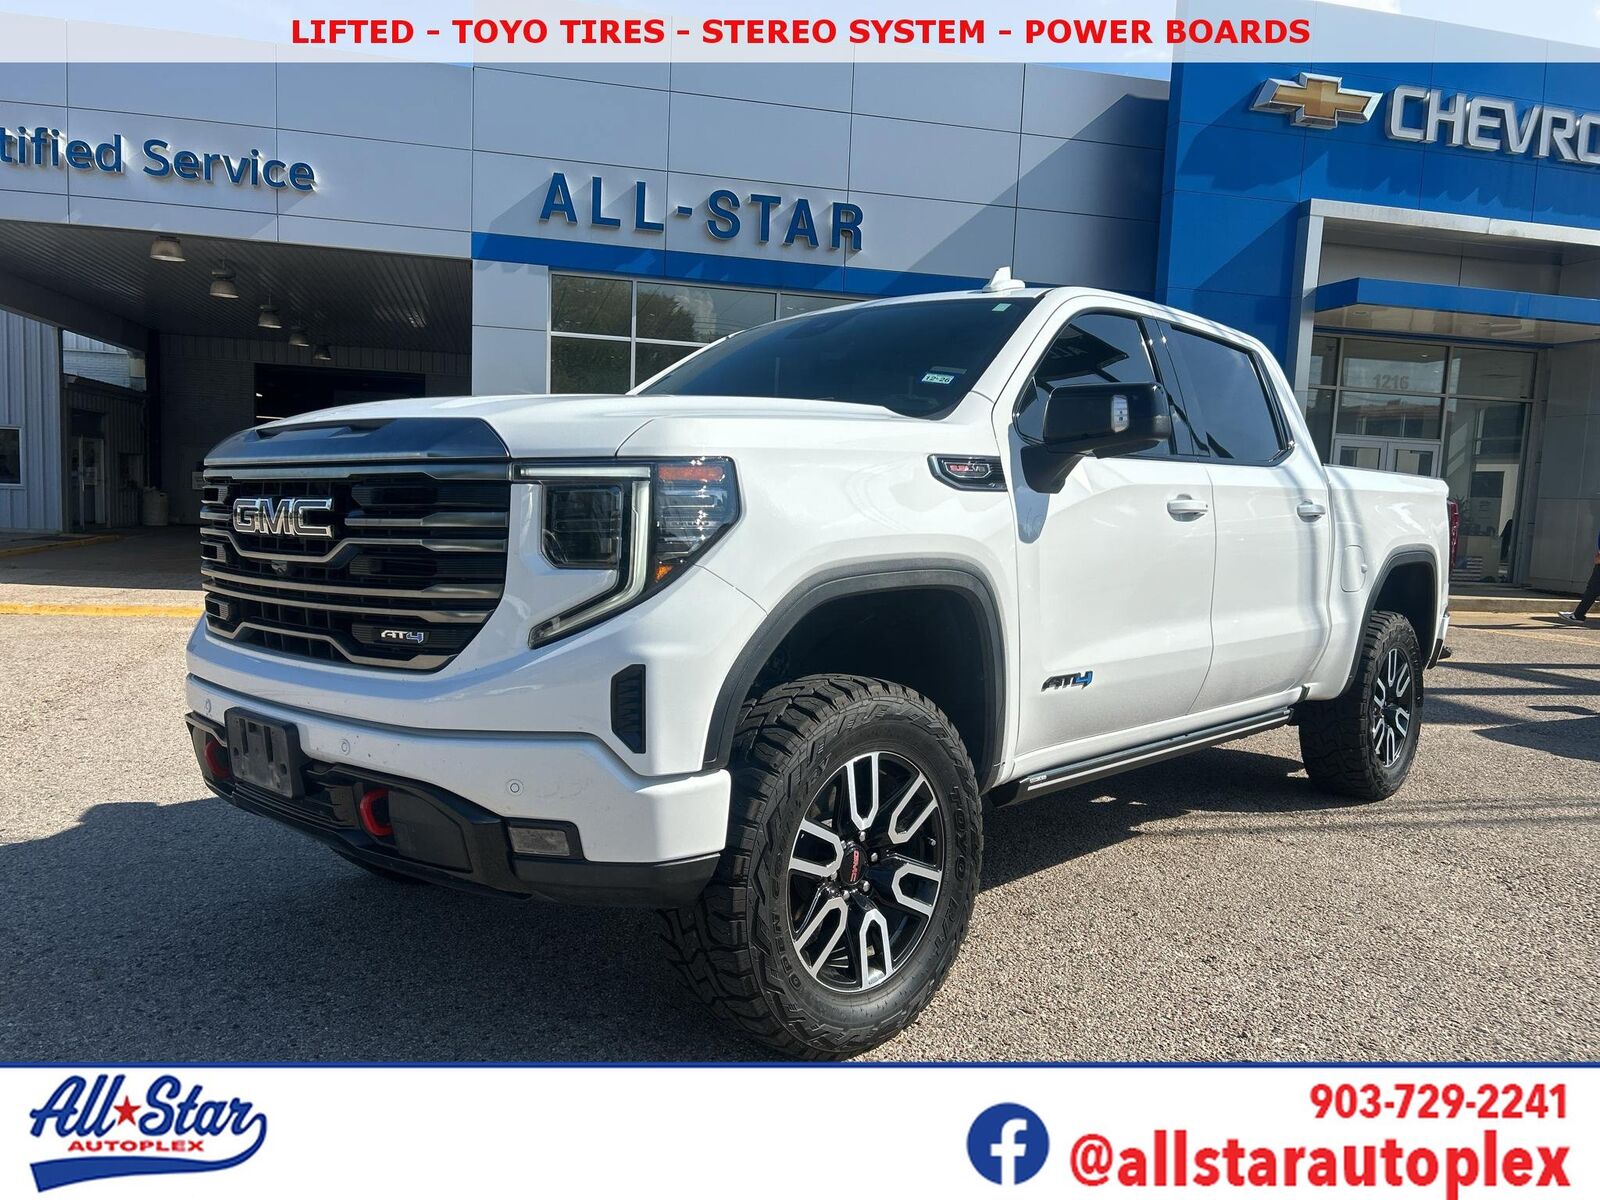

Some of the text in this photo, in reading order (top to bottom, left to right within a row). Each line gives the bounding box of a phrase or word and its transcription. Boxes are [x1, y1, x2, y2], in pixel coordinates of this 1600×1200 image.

[142, 139, 316, 191] Service
[539, 172, 864, 251] ALL-STAR
[1373, 374, 1410, 390] 1216
[233, 498, 333, 538] GMC
[381, 629, 424, 644] AT4
[1041, 671, 1093, 692] AT4
[850, 848, 860, 883] GMC
